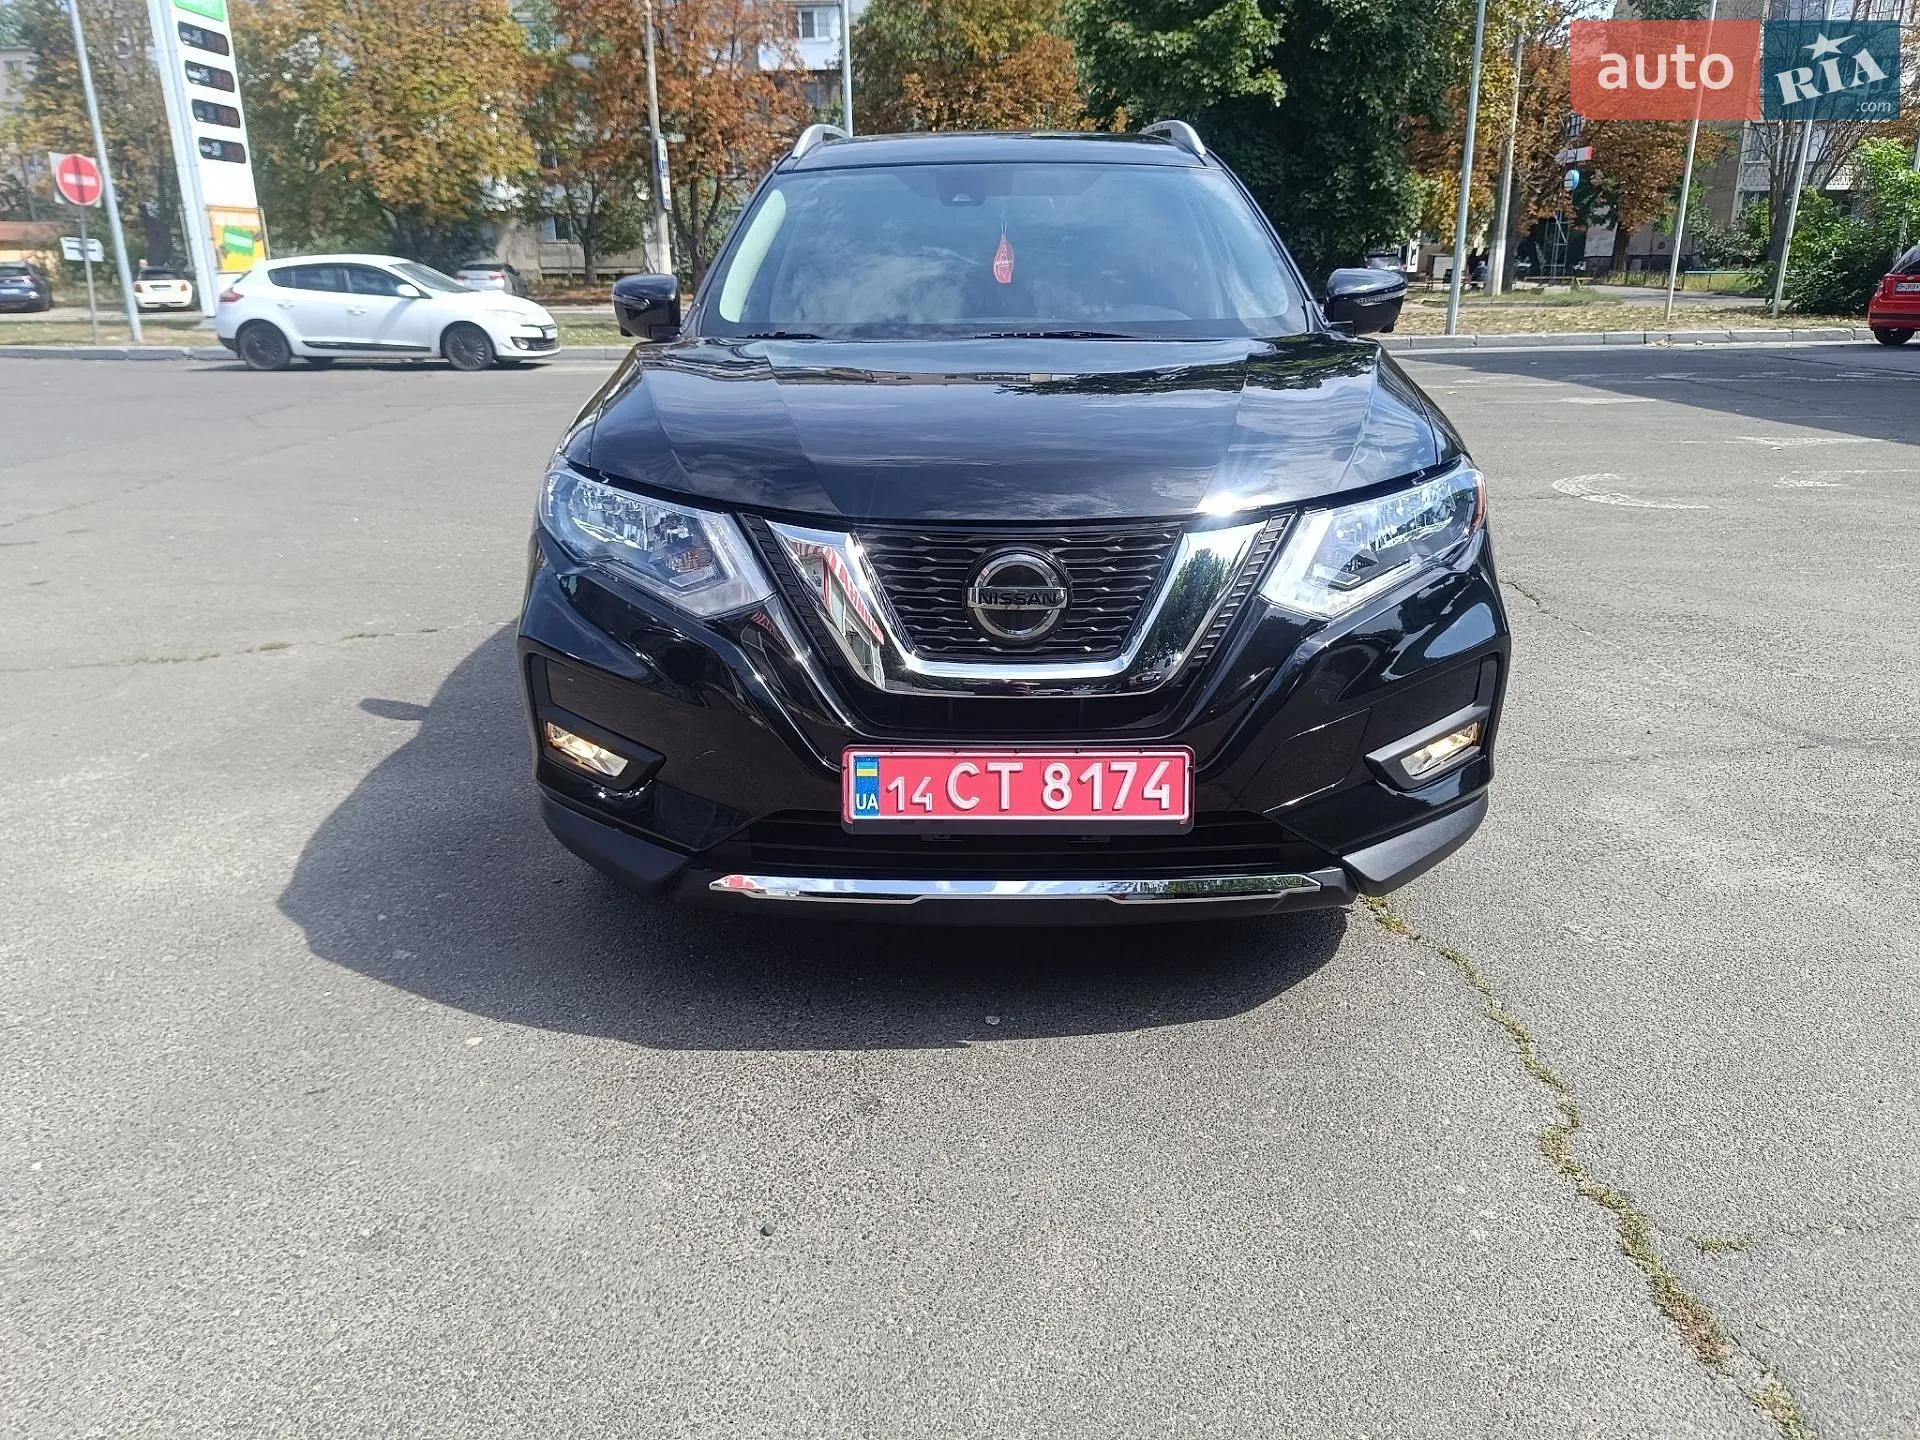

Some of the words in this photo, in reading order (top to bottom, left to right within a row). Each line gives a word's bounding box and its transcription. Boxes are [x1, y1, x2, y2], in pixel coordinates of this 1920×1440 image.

[979, 591, 1057, 606] NISSAN
[886, 776, 934, 812] 14
[945, 761, 1024, 812] CT
[1041, 760, 1171, 811] 8174
[856, 793, 879, 810] UA
